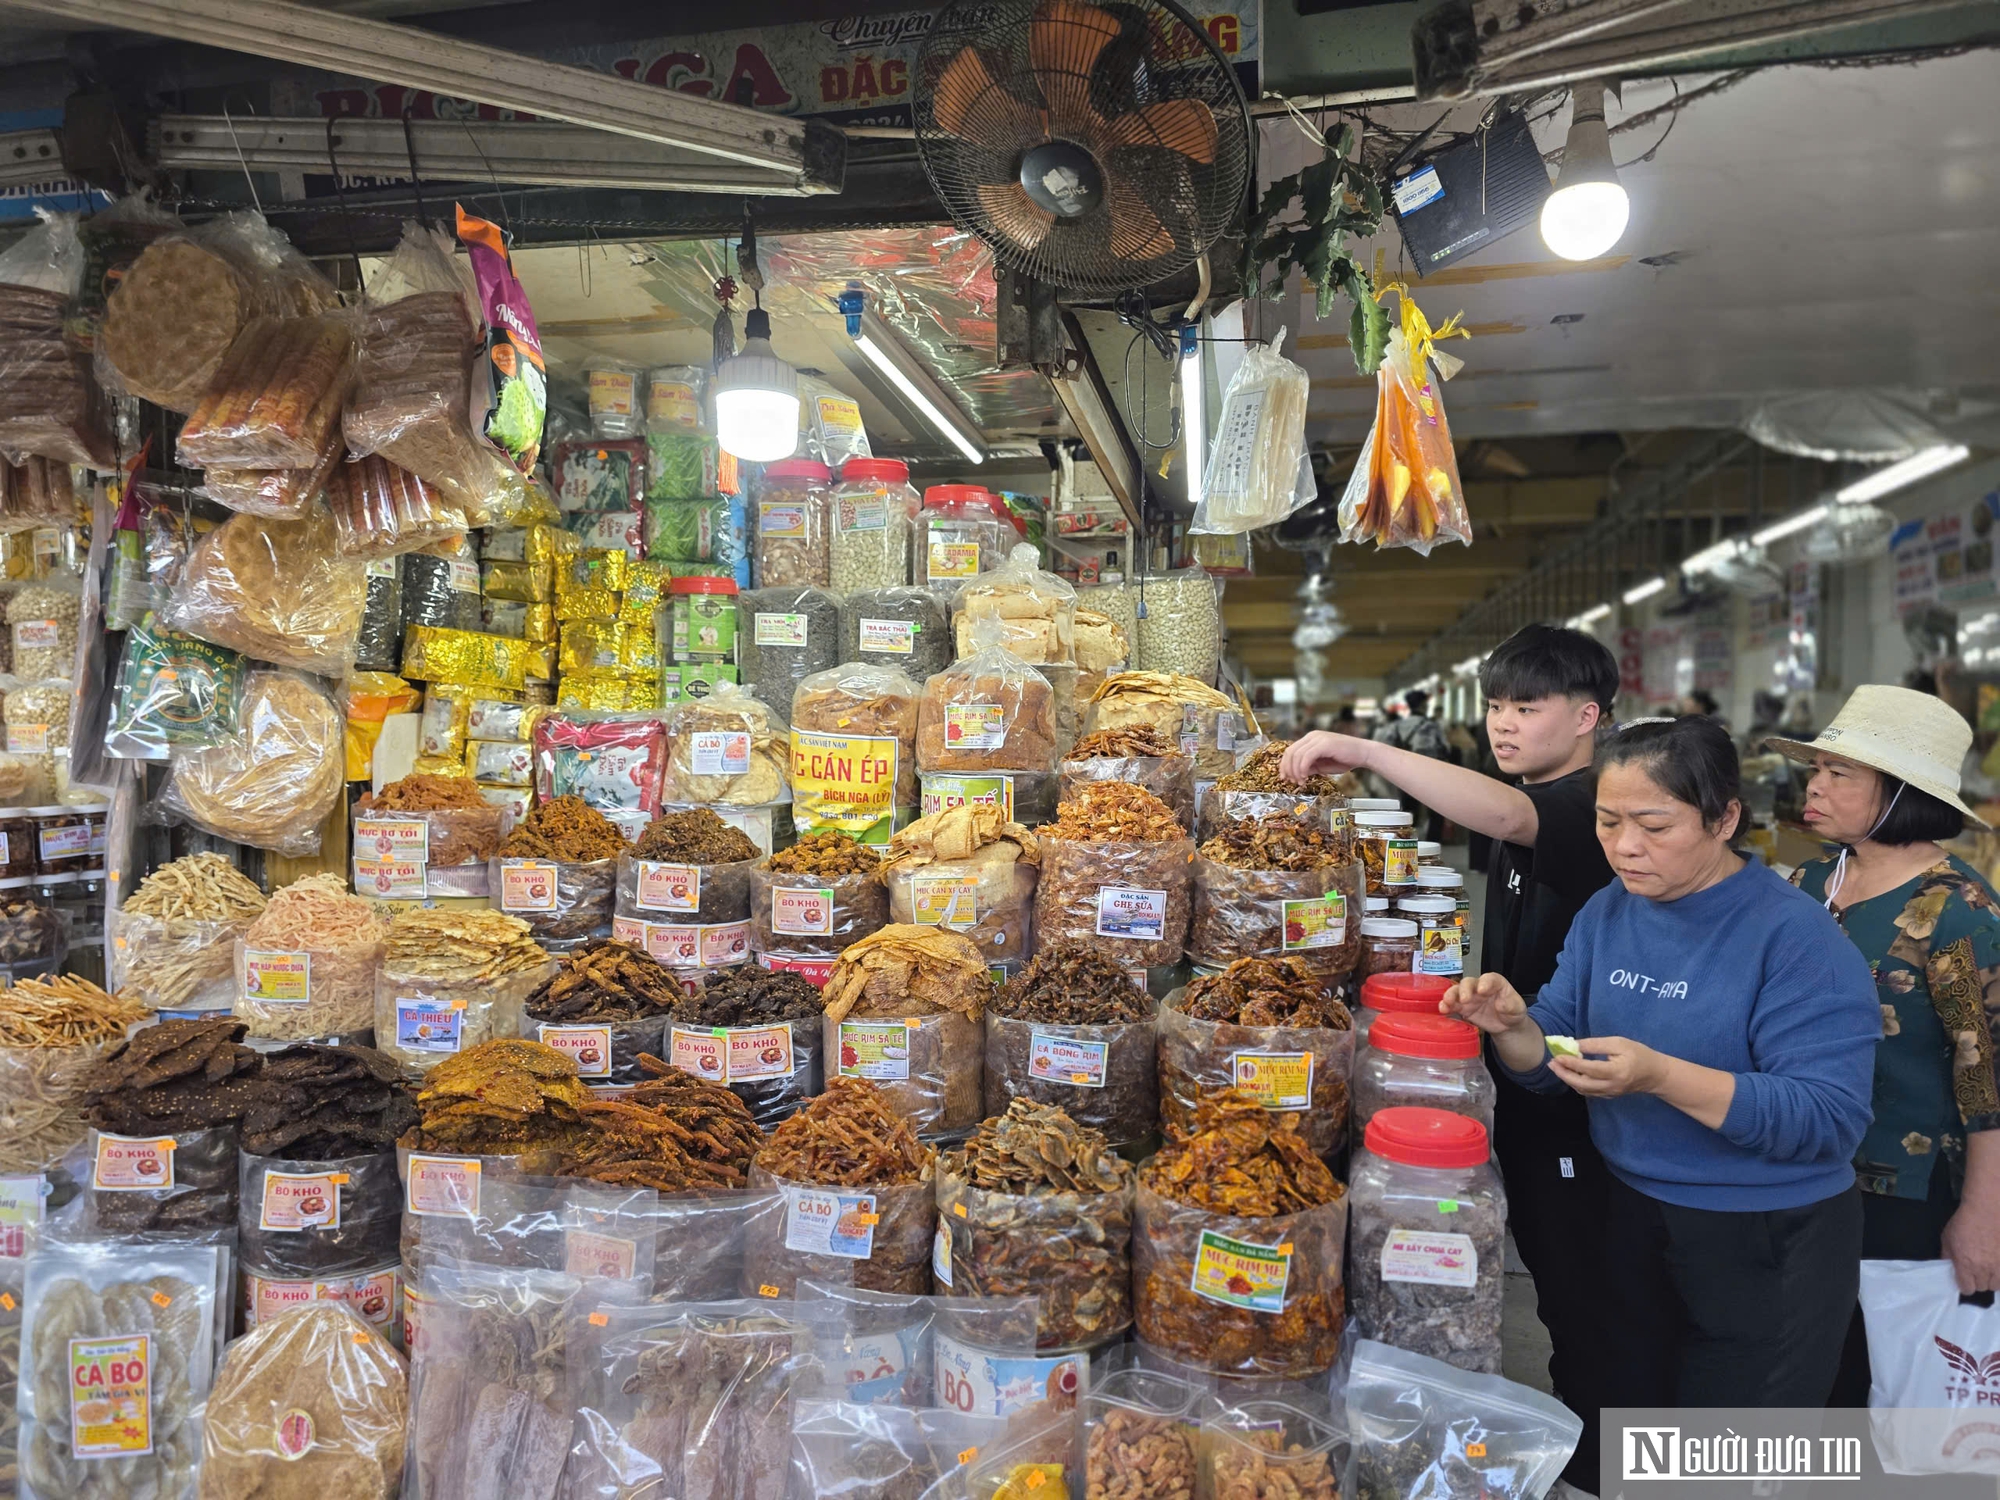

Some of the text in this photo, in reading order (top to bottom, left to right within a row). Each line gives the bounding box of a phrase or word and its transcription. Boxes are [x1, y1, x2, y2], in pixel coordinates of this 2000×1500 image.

[819, 12, 932, 47] Chuyên
[820, 55, 908, 106] ĐẶC
[832, 740, 848, 749] NAM
[811, 751, 888, 784] CÁN ÉP
[823, 788, 846, 803] BÍCH
[848, 792, 869, 804] NGA
[924, 794, 941, 815] RIM
[381, 828, 396, 838] BƠ
[958, 886, 972, 895] CAY
[1113, 899, 1153, 911] GHE SỮA
[1323, 906, 1333, 915] SA
[1609, 968, 1689, 999] ONT-AYA
[551, 1037, 597, 1047] BÒ KHÔ
[732, 1036, 779, 1050] BÒ KHÔ
[861, 1033, 876, 1043] RIM
[878, 1034, 889, 1044] SA
[678, 1040, 716, 1055] BÒ KHÔ
[1082, 1051, 1100, 1061] RIM
[1279, 1065, 1295, 1075] RIM
[798, 1198, 814, 1213] CÁ
[816, 1201, 832, 1216] BÒ
[1423, 1245, 1446, 1254] CHUA
[1447, 1247, 1463, 1256] CAY
[1235, 1258, 1261, 1274] RIM
[74, 1355, 144, 1387] CÁ BÒ
[943, 1366, 975, 1413] BÒ
[1945, 1386, 1970, 1402] TP
